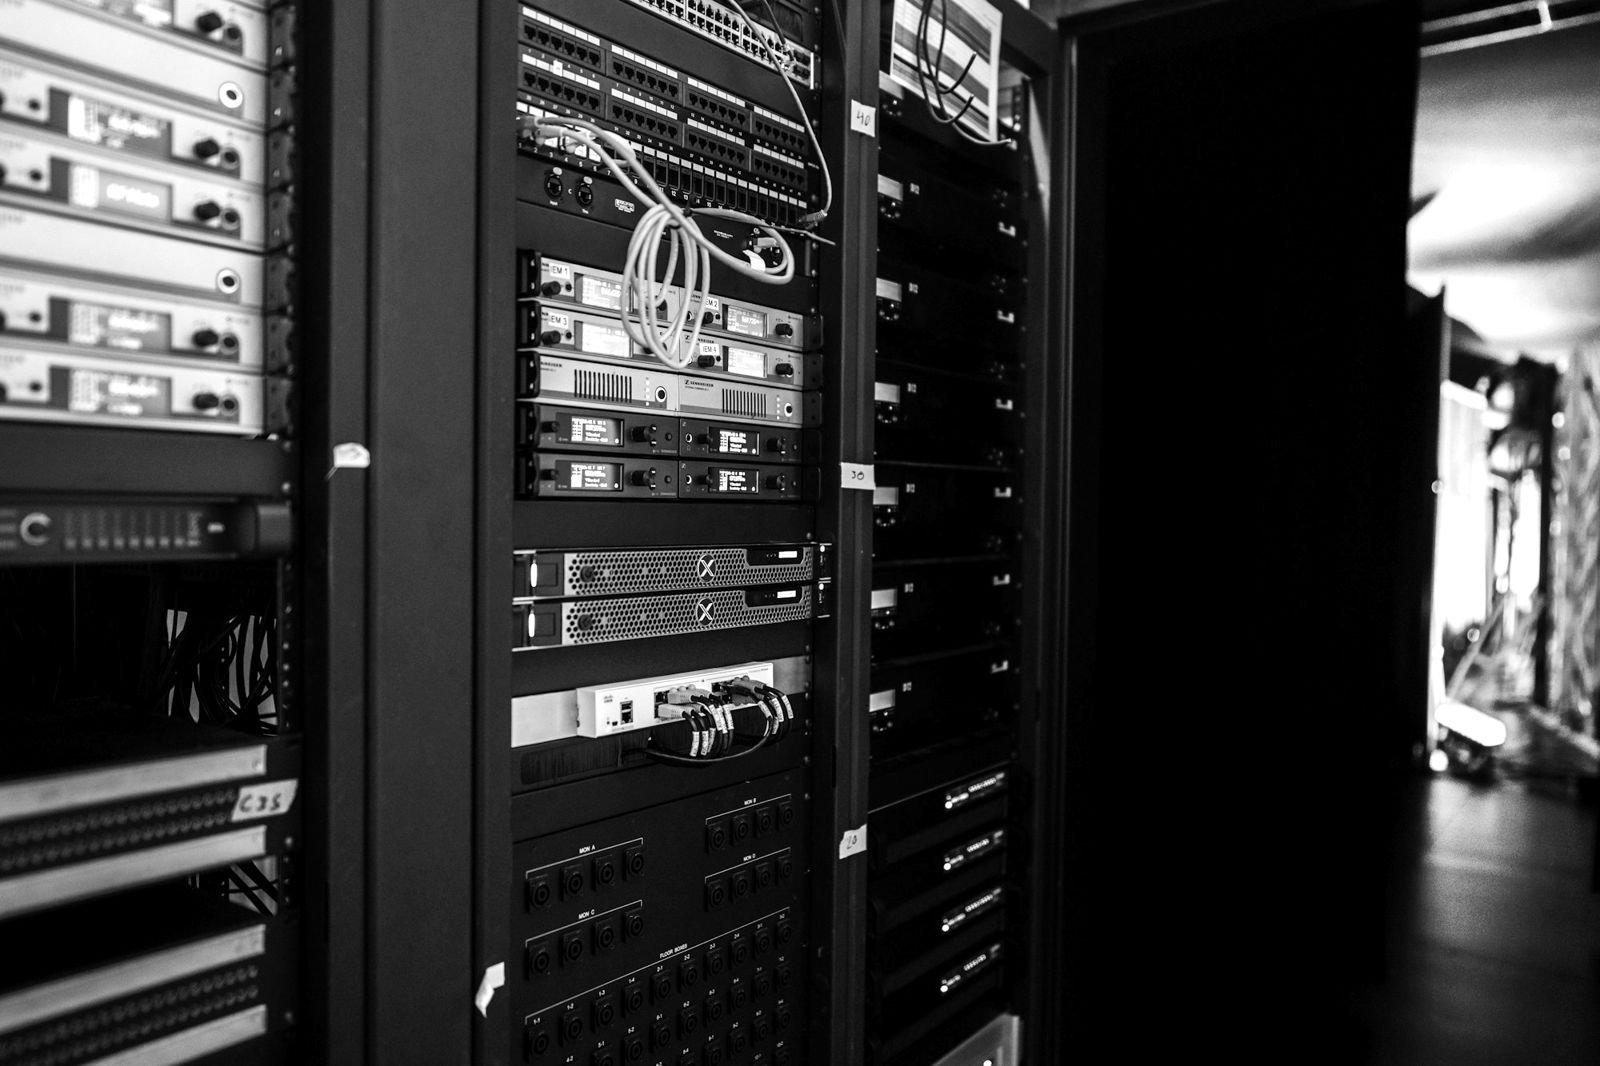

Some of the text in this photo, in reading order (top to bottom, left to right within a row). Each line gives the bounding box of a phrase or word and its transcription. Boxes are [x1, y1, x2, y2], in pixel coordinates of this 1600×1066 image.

[856, 110, 871, 126] 40
[851, 470, 865, 481] 30
[579, 846, 591, 854] MON
[578, 911, 590, 920] MON
